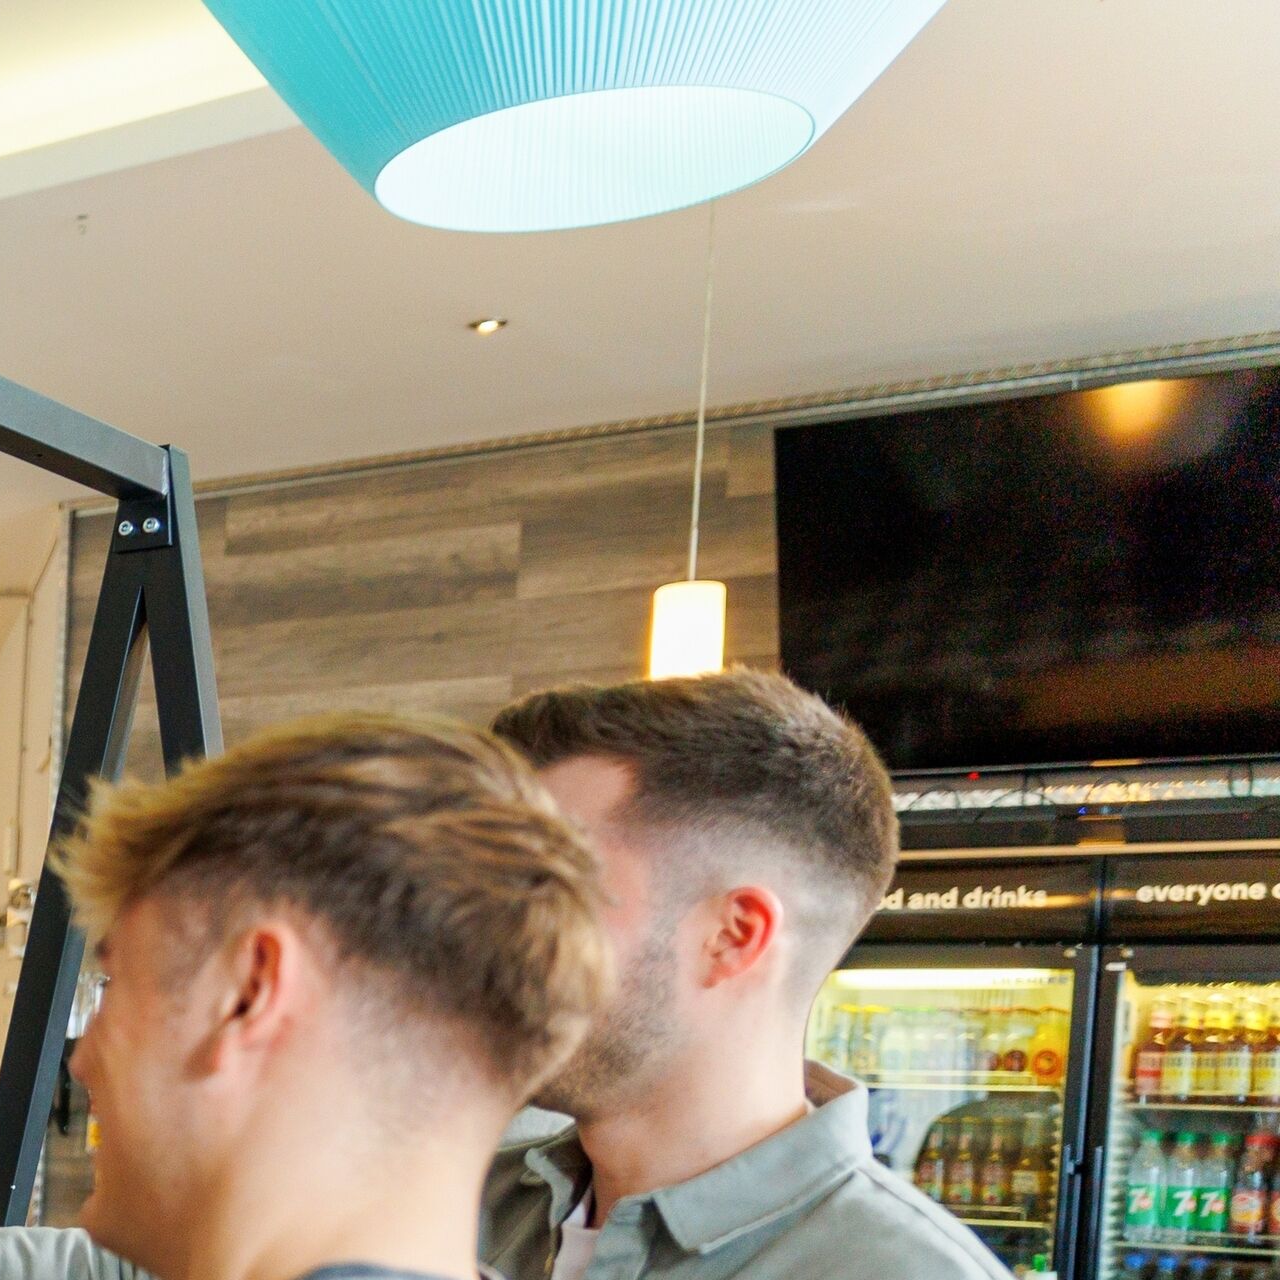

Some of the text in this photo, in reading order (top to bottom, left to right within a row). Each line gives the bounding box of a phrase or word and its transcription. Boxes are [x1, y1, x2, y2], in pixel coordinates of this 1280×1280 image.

[907, 886, 959, 910] and
[961, 884, 1048, 910] drinks
[1135, 882, 1267, 907] everyone
